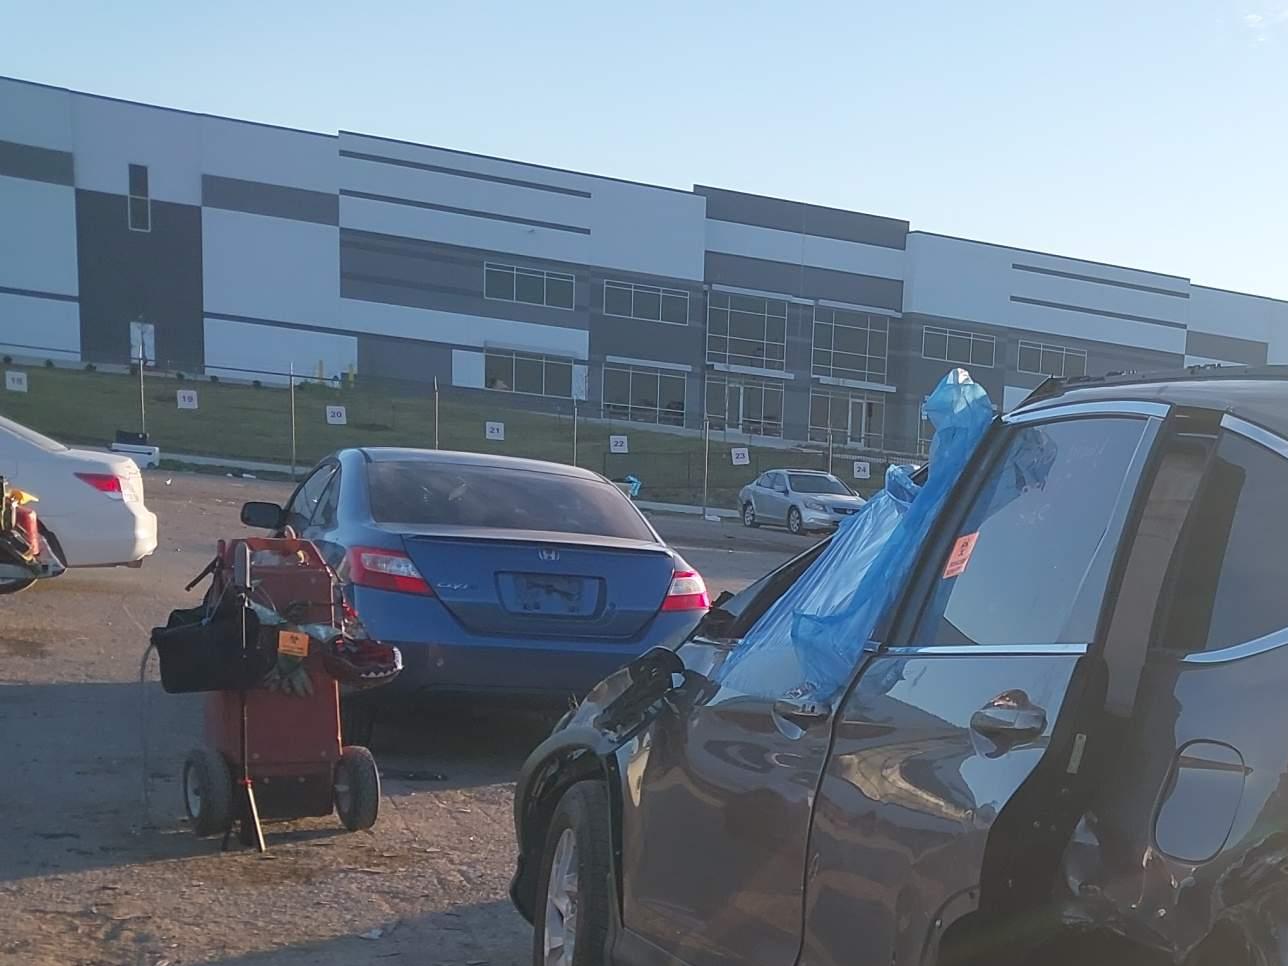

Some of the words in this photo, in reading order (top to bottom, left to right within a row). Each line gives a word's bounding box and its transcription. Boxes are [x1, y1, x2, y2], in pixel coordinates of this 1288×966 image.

[329, 410, 342, 418] 20
[489, 426, 500, 434] 21
[613, 440, 624, 448] 22
[735, 452, 746, 460] 23
[856, 465, 867, 473] 24
